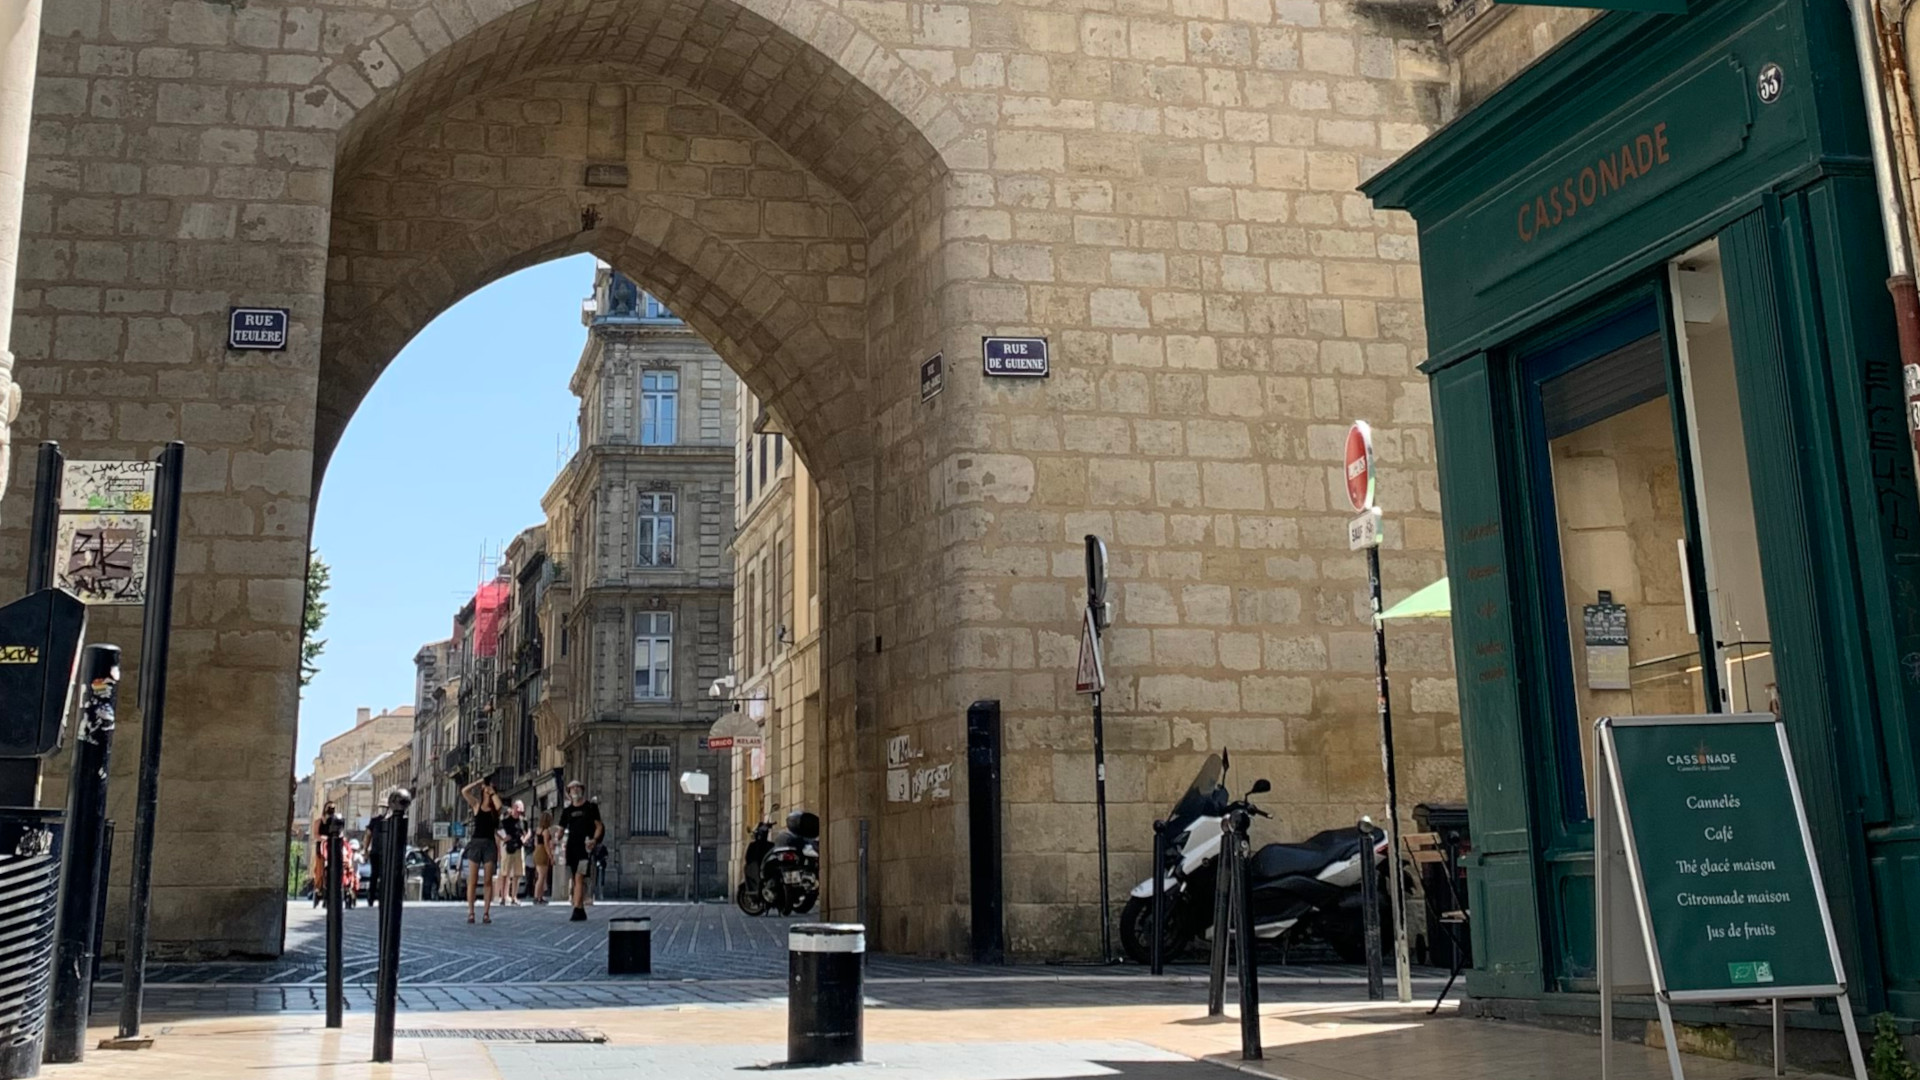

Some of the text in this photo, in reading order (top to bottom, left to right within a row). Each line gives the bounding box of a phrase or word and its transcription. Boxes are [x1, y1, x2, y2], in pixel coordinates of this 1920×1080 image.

[1760, 67, 1778, 99] 53
[1517, 121, 1670, 242] CASSONADE
[245, 314, 274, 326] RUE
[235, 329, 282, 342] TEULÈRE
[1003, 343, 1028, 355] RUE
[989, 358, 1045, 370] DE GUIENNE
[711, 738, 732, 747] BRICO
[1686, 794, 1741, 810] Cannelés
[1704, 825, 1734, 843] Café
[1676, 858, 1776, 877] Thé glacé maison
[1677, 890, 1791, 906] Citronnade maison
[1707, 922, 1777, 941] Jus de fruits
